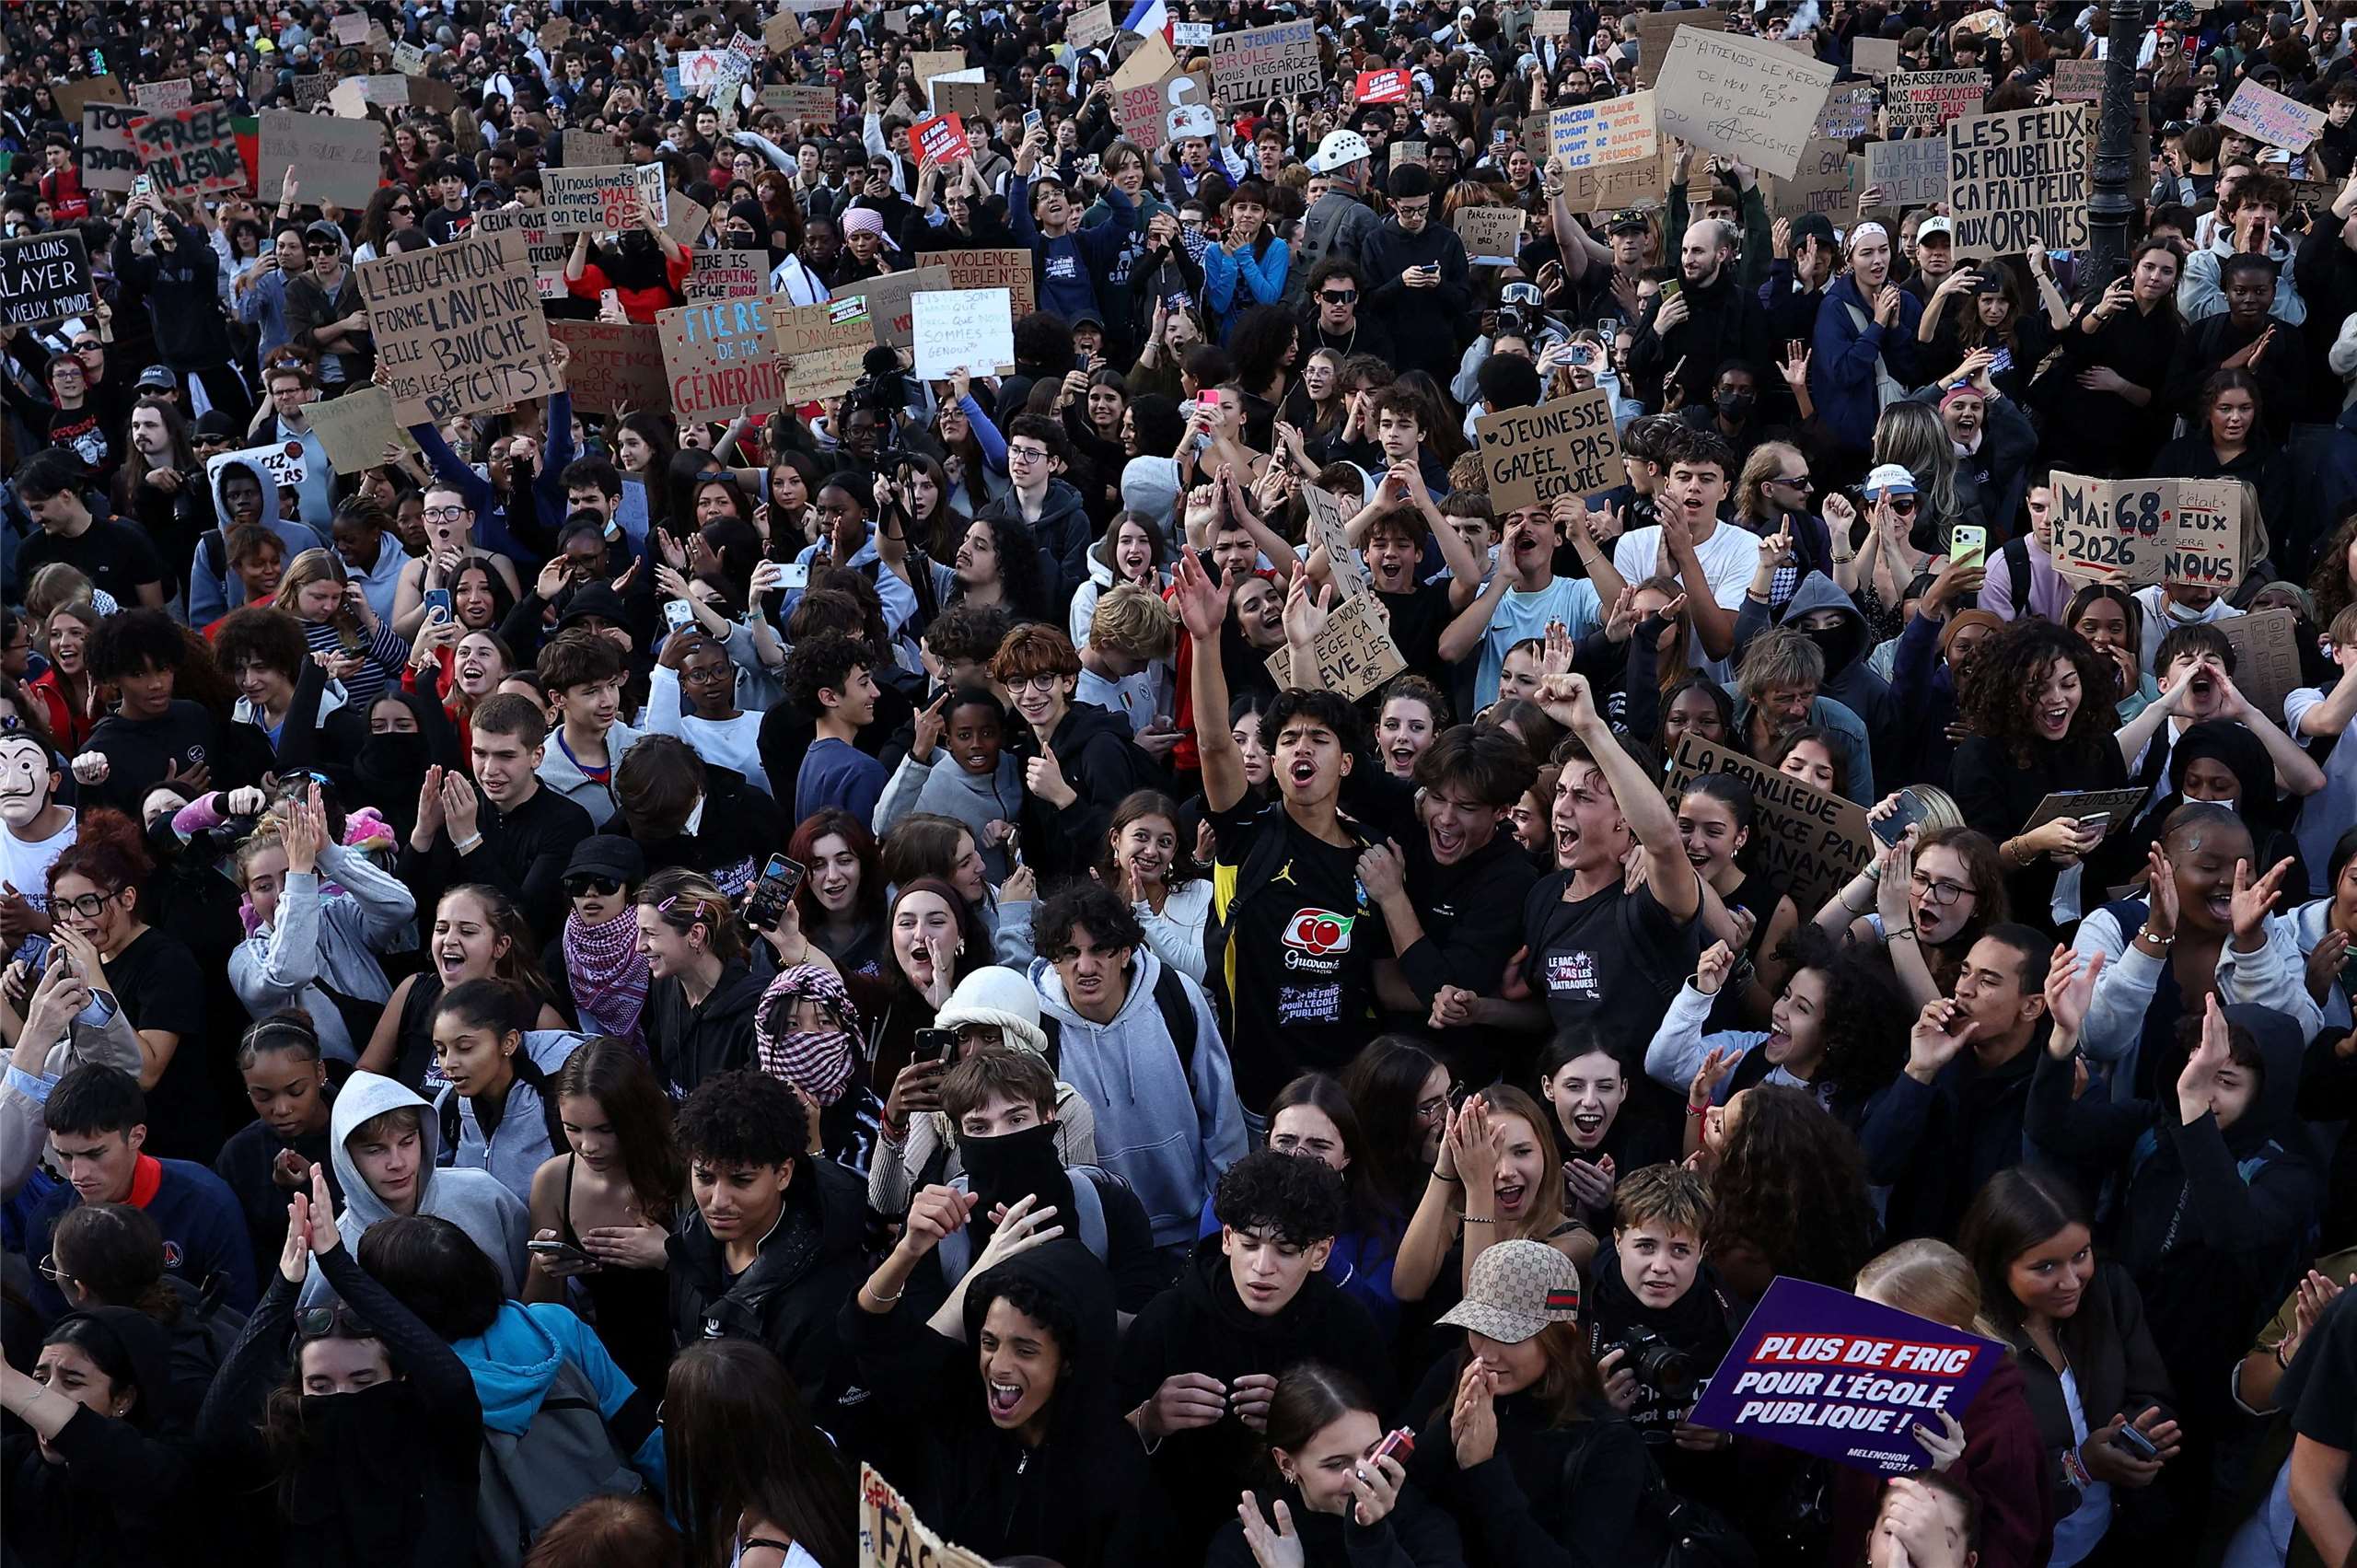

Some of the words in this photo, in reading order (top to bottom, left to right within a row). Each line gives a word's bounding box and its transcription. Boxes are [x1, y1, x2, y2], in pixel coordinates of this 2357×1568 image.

[1213, 37, 1236, 54] LA
[1243, 25, 1312, 47] JEUNESSE
[1283, 41, 1309, 55] ET
[1216, 69, 1245, 82] VOUS
[1253, 55, 1318, 76] REGARDEZ
[1673, 36, 1757, 67] J'ATTENDS
[1760, 62, 1781, 76] LE
[1786, 72, 1831, 89] RETOUR
[1218, 70, 1319, 103] AILLEURS
[1696, 70, 1716, 83] DE
[1724, 77, 1749, 91] MON
[1890, 73, 1910, 87] PAS
[1912, 72, 1944, 84] ASSEZ
[1945, 71, 1977, 84] POUR
[1122, 87, 1159, 108] SOIS
[1701, 92, 1732, 110] PAS
[1737, 105, 1772, 121] CELUI
[1889, 90, 1909, 102] NOS
[1913, 101, 1937, 113] TJRS
[1941, 101, 1966, 112] PLUS
[1123, 102, 1162, 122] JEUNE
[1554, 109, 1595, 125] MACRON
[1889, 114, 1915, 126] POUR
[139, 107, 232, 150] FREE
[1554, 125, 1589, 140] DEVANT
[1596, 121, 1609, 132] TA
[1663, 108, 1689, 122] DU
[1707, 117, 1797, 157] FASCISME
[1951, 118, 2010, 150] LES
[2017, 107, 2085, 142] FEUX
[921, 135, 930, 145] LE
[1133, 136, 1157, 149] TOI
[1558, 139, 1588, 154] AVANT
[1596, 137, 1608, 147] DE
[1570, 154, 1591, 167] LES
[1597, 145, 1643, 163] JEUNES
[1874, 146, 1888, 164] LA
[1897, 141, 1947, 163] POLICE
[1952, 151, 1979, 181] DE
[1983, 140, 2085, 179] POUBELLES
[567, 177, 594, 191] nous
[595, 173, 604, 188] la
[604, 171, 634, 187] mets
[1873, 163, 1898, 178] NOUS
[547, 190, 556, 205] à
[558, 192, 599, 205] l'envers
[1915, 179, 1938, 200] LES
[1952, 183, 1980, 215] ÇA
[2037, 172, 2084, 205] PEUR
[480, 214, 514, 232] CEUX
[518, 213, 547, 229] QUI
[551, 210, 570, 223] on
[572, 208, 588, 223] te
[589, 207, 603, 223] la
[604, 204, 639, 229] 68
[1468, 209, 1517, 220] PARCOURSUP
[1955, 215, 1989, 248] AUX
[1990, 205, 2088, 252] ORDURES
[17, 239, 69, 265] ALLONS
[692, 254, 723, 270] FIRE
[729, 253, 749, 269] IS
[363, 238, 505, 302] L'ÉDUCATION
[698, 269, 758, 285] CATCHING
[950, 270, 994, 284] PEUPLE
[998, 267, 1032, 284] N'EST
[691, 285, 707, 297] IF
[707, 285, 726, 297] WE
[728, 285, 758, 296] BURN
[52, 292, 94, 316] MONDE
[375, 302, 429, 333] FORME
[382, 340, 424, 366] ELLE
[428, 315, 537, 373] BOUCHE
[923, 329, 982, 343] SOMMES
[716, 342, 736, 360] DE
[741, 338, 760, 357] MA
[586, 366, 613, 383] OR
[391, 377, 420, 399] PAS
[421, 373, 451, 395] LES
[1500, 399, 1609, 447] JEUNESSE
[1570, 432, 1615, 465] PAS
[1534, 462, 1609, 501] ÉCOUTÉE
[2115, 492, 2160, 536] 68
[2179, 513, 2227, 532] EUX
[2068, 529, 2136, 565] 2026
[2175, 538, 2204, 548] SERA
[2165, 552, 2234, 580] NOUS
[1338, 597, 1367, 624] NOUS
[1353, 621, 1372, 644] ÇA
[1364, 634, 1390, 662] LES
[1319, 651, 1362, 691] EVE
[1678, 739, 1714, 773] LA
[1284, 949, 1340, 970] Guaraná
[1549, 958, 1558, 968] LE
[1559, 957, 1576, 967] BAC,
[1551, 978, 1594, 990] MATRAQUES
[1561, 967, 1577, 979] PAS
[1578, 968, 1592, 978] LES
[1306, 989, 1318, 999] DE
[1318, 985, 1340, 998] FRIC
[1282, 1002, 1303, 1011] POUR
[1304, 997, 1339, 1008] L'ÉCOLE
[1289, 1006, 1334, 1019] PUBLIQUE
[1590, 1321, 1600, 1355] Canon
[1755, 1336, 1844, 1362] PLUS
[1842, 1340, 1894, 1365] DE
[1890, 1345, 1972, 1374] FRIC
[1732, 1371, 1824, 1395] POUR
[1823, 1373, 1955, 1409] L'ÉCOLE
[1736, 1400, 1897, 1433] PUBLIQUE
[1893, 1412, 1913, 1434] !
[1847, 1447, 1910, 1462] MELENCHON
